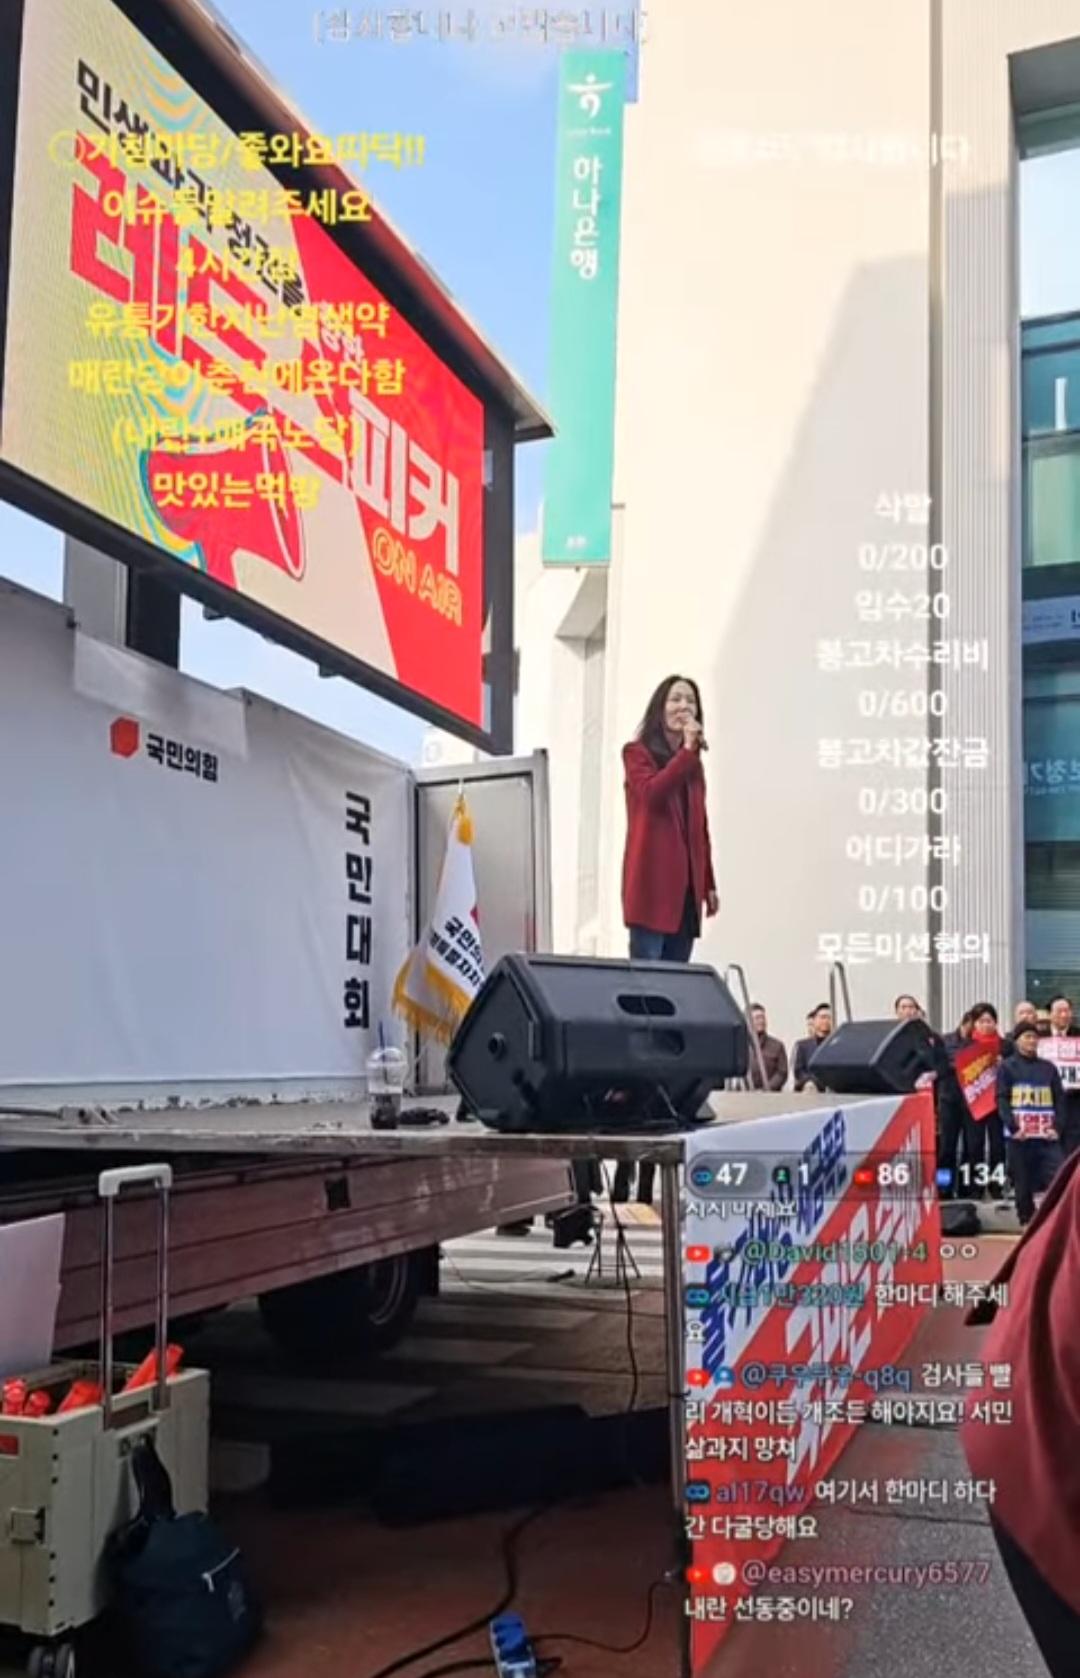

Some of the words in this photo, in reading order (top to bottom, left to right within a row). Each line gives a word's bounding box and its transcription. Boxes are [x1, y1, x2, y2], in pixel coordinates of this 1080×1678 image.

[570, 154, 603, 280] 하나은행
[146, 732, 219, 783] 국민의힘
[343, 790, 373, 1030] 국민대회
